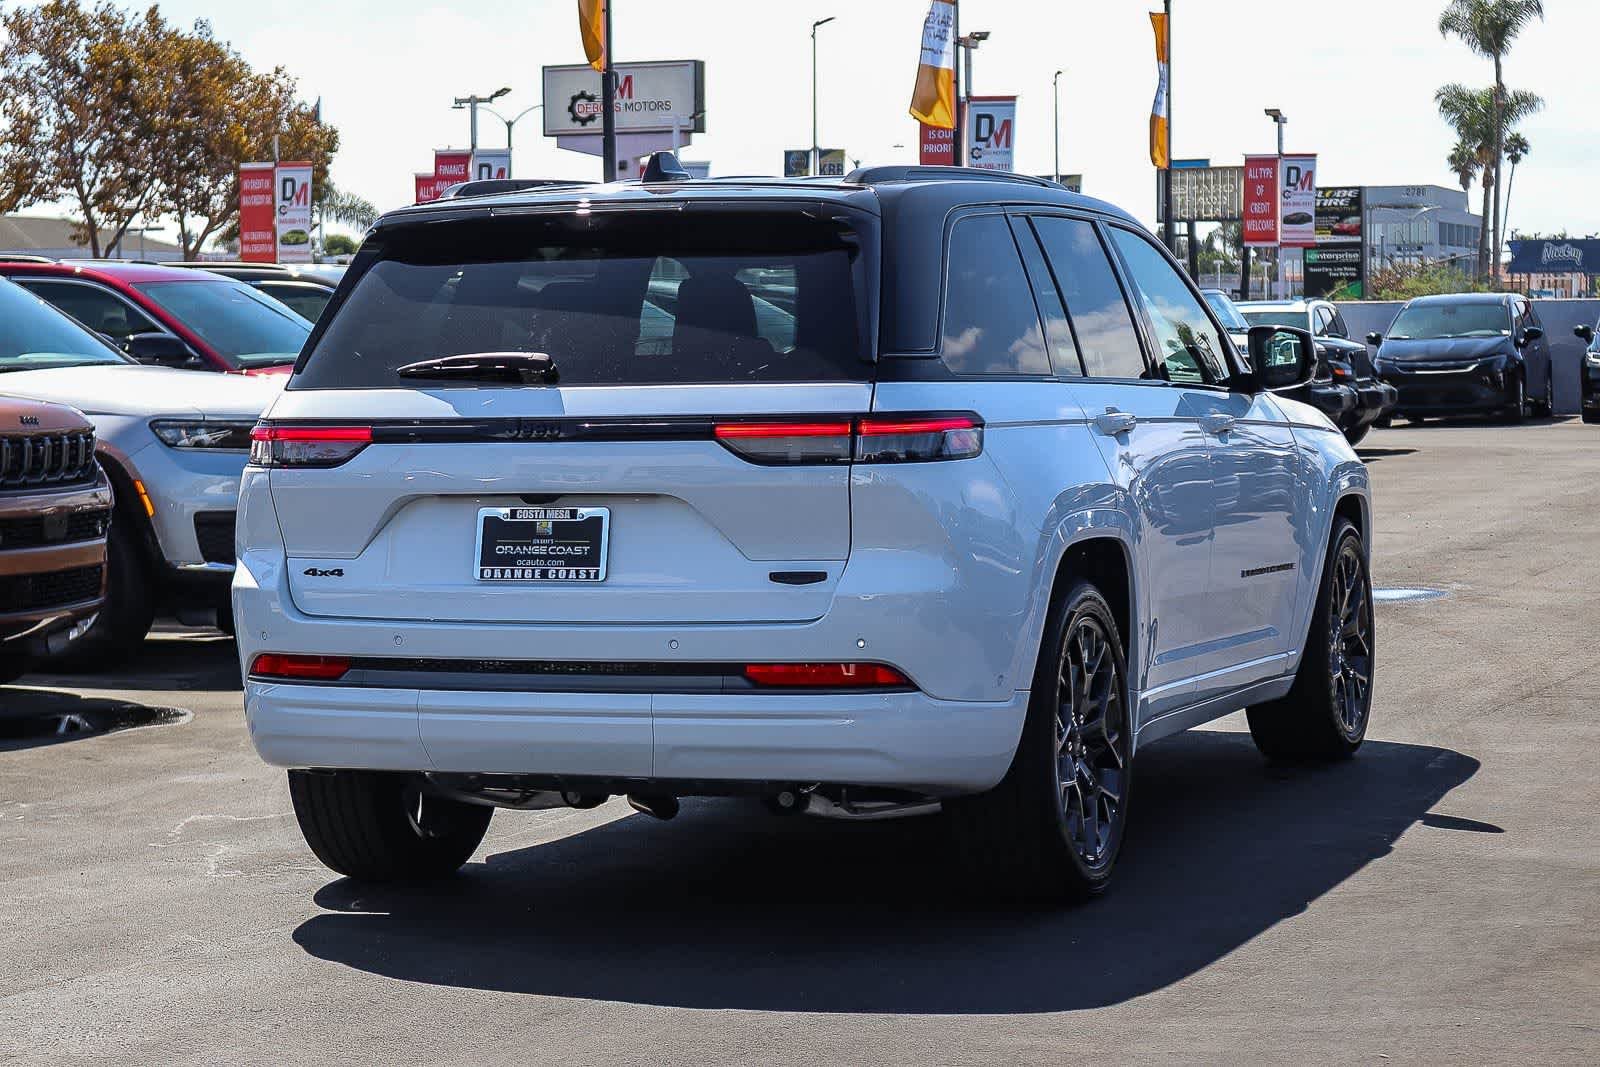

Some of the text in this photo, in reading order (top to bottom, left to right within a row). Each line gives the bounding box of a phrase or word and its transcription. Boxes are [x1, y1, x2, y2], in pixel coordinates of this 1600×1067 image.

[625, 100, 671, 112] MOTORS
[928, 130, 936, 139] IS
[976, 113, 1012, 148] DM
[439, 164, 465, 174] FINANCE
[1248, 168, 1259, 179] ALL
[1260, 168, 1273, 179] TYPE
[1286, 166, 1313, 191] DM
[282, 177, 309, 206] DM
[1256, 184, 1265, 197] OF
[1250, 202, 1270, 214] CREDIT
[1247, 219, 1275, 232] WELCOME
[1307, 252, 1359, 261] enterprise
[516, 509, 571, 519] COSTA MESA
[516, 558, 565, 566] ocauto.com
[303, 568, 345, 577] 4x4
[483, 568, 597, 579] ORANGE COAST
